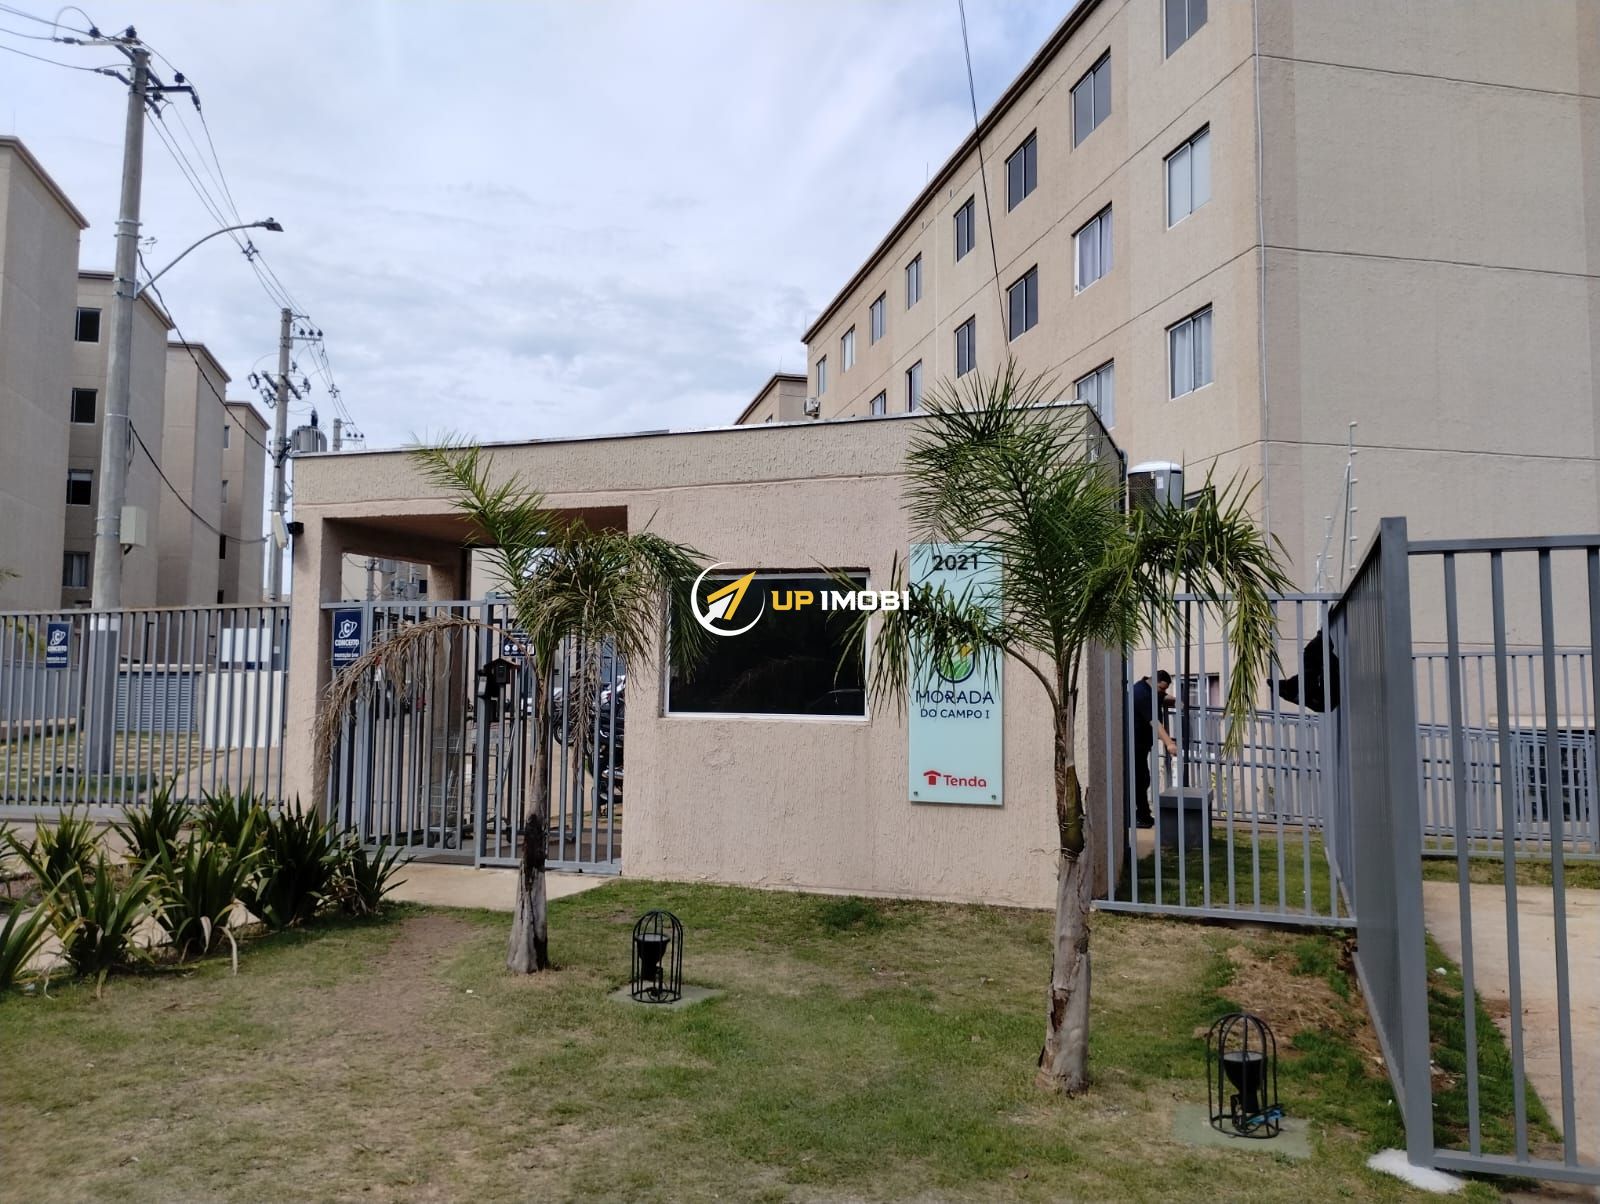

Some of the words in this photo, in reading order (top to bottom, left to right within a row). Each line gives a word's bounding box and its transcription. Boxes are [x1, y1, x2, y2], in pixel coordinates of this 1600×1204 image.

[932, 554, 978, 571] 2021
[915, 690, 995, 705] MORADA
[920, 708, 937, 718] DO
[940, 709, 983, 719] CAMPO
[985, 710, 990, 719] I
[943, 774, 987, 788] Tenda
